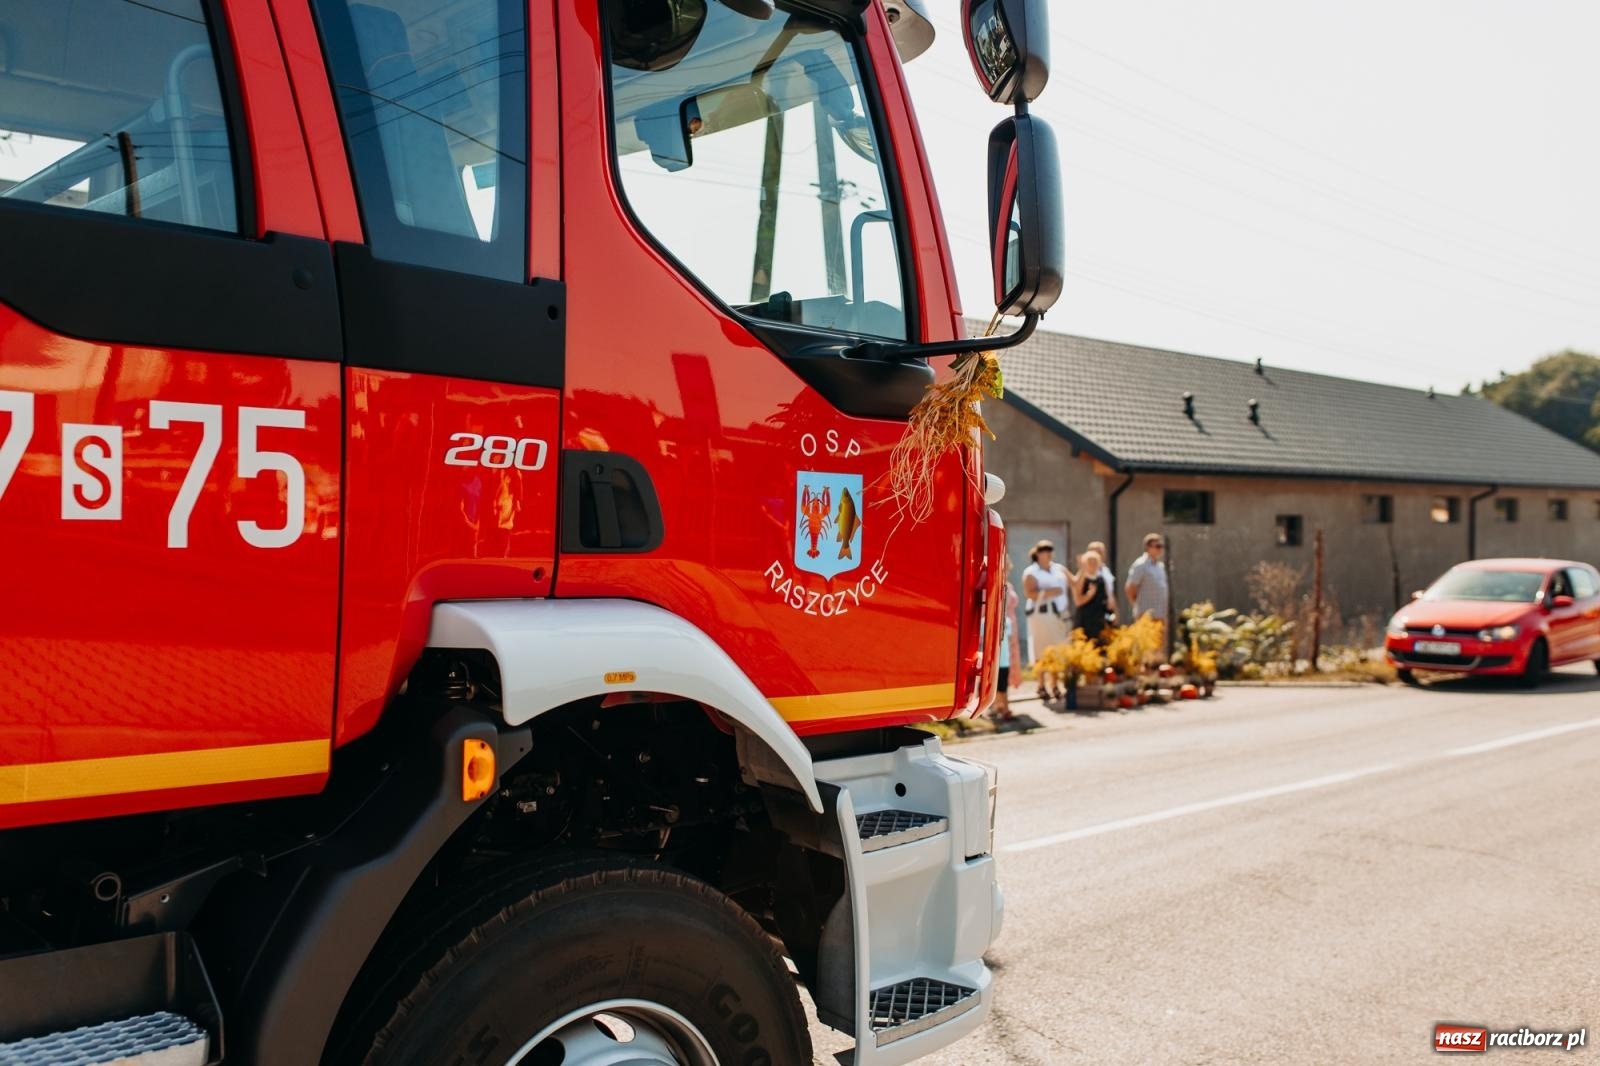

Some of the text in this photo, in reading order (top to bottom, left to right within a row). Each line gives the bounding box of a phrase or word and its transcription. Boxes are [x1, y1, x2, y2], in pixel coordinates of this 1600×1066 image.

[72, 434, 112, 510] S
[149, 400, 306, 548] 75
[444, 432, 548, 471] 280
[763, 559, 889, 617] RASZCZYCE
